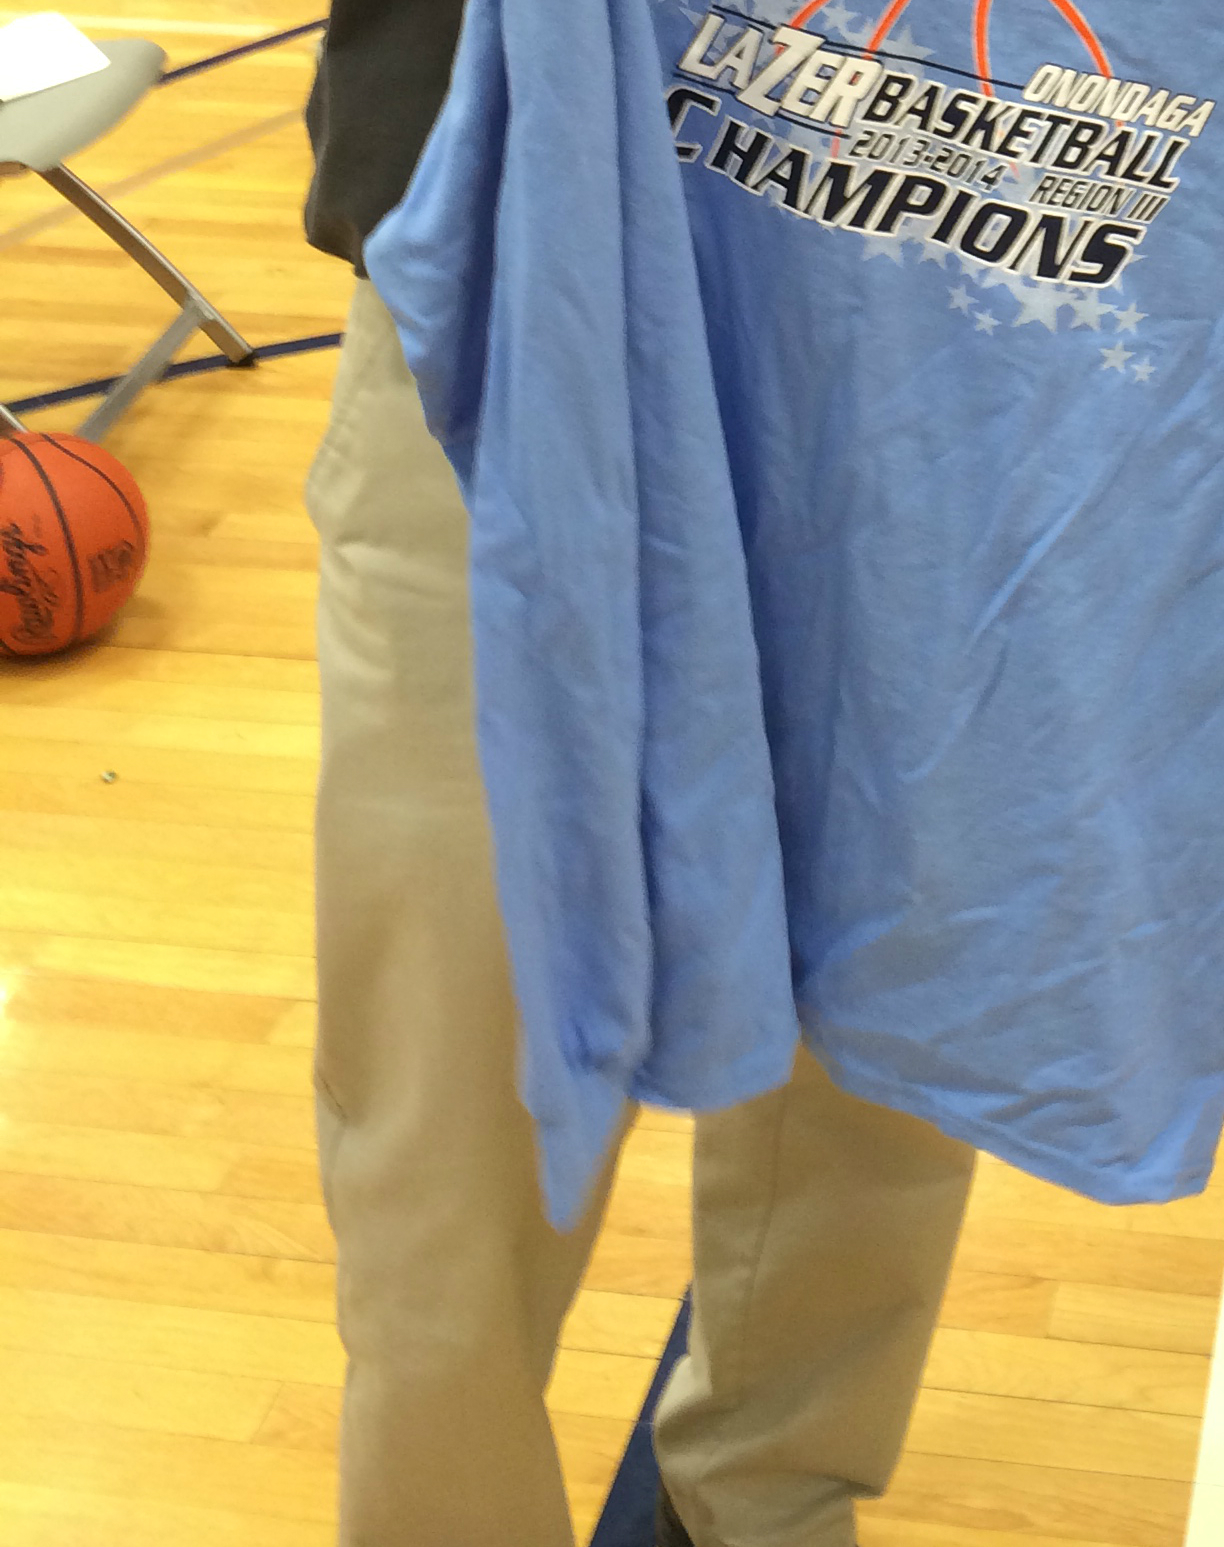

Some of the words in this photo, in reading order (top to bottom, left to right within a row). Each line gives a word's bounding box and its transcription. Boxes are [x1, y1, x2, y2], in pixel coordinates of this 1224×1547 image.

[677, 10, 884, 129] LAZER
[859, 71, 1189, 192] BASKETBALL
[1021, 62, 1216, 138] ONONDAGA
[667, 86, 1147, 288] CHAMPIONS
[850, 130, 1008, 192] 2013-2014
[1029, 174, 1134, 216] REGION
[1125, 192, 1170, 223] III
